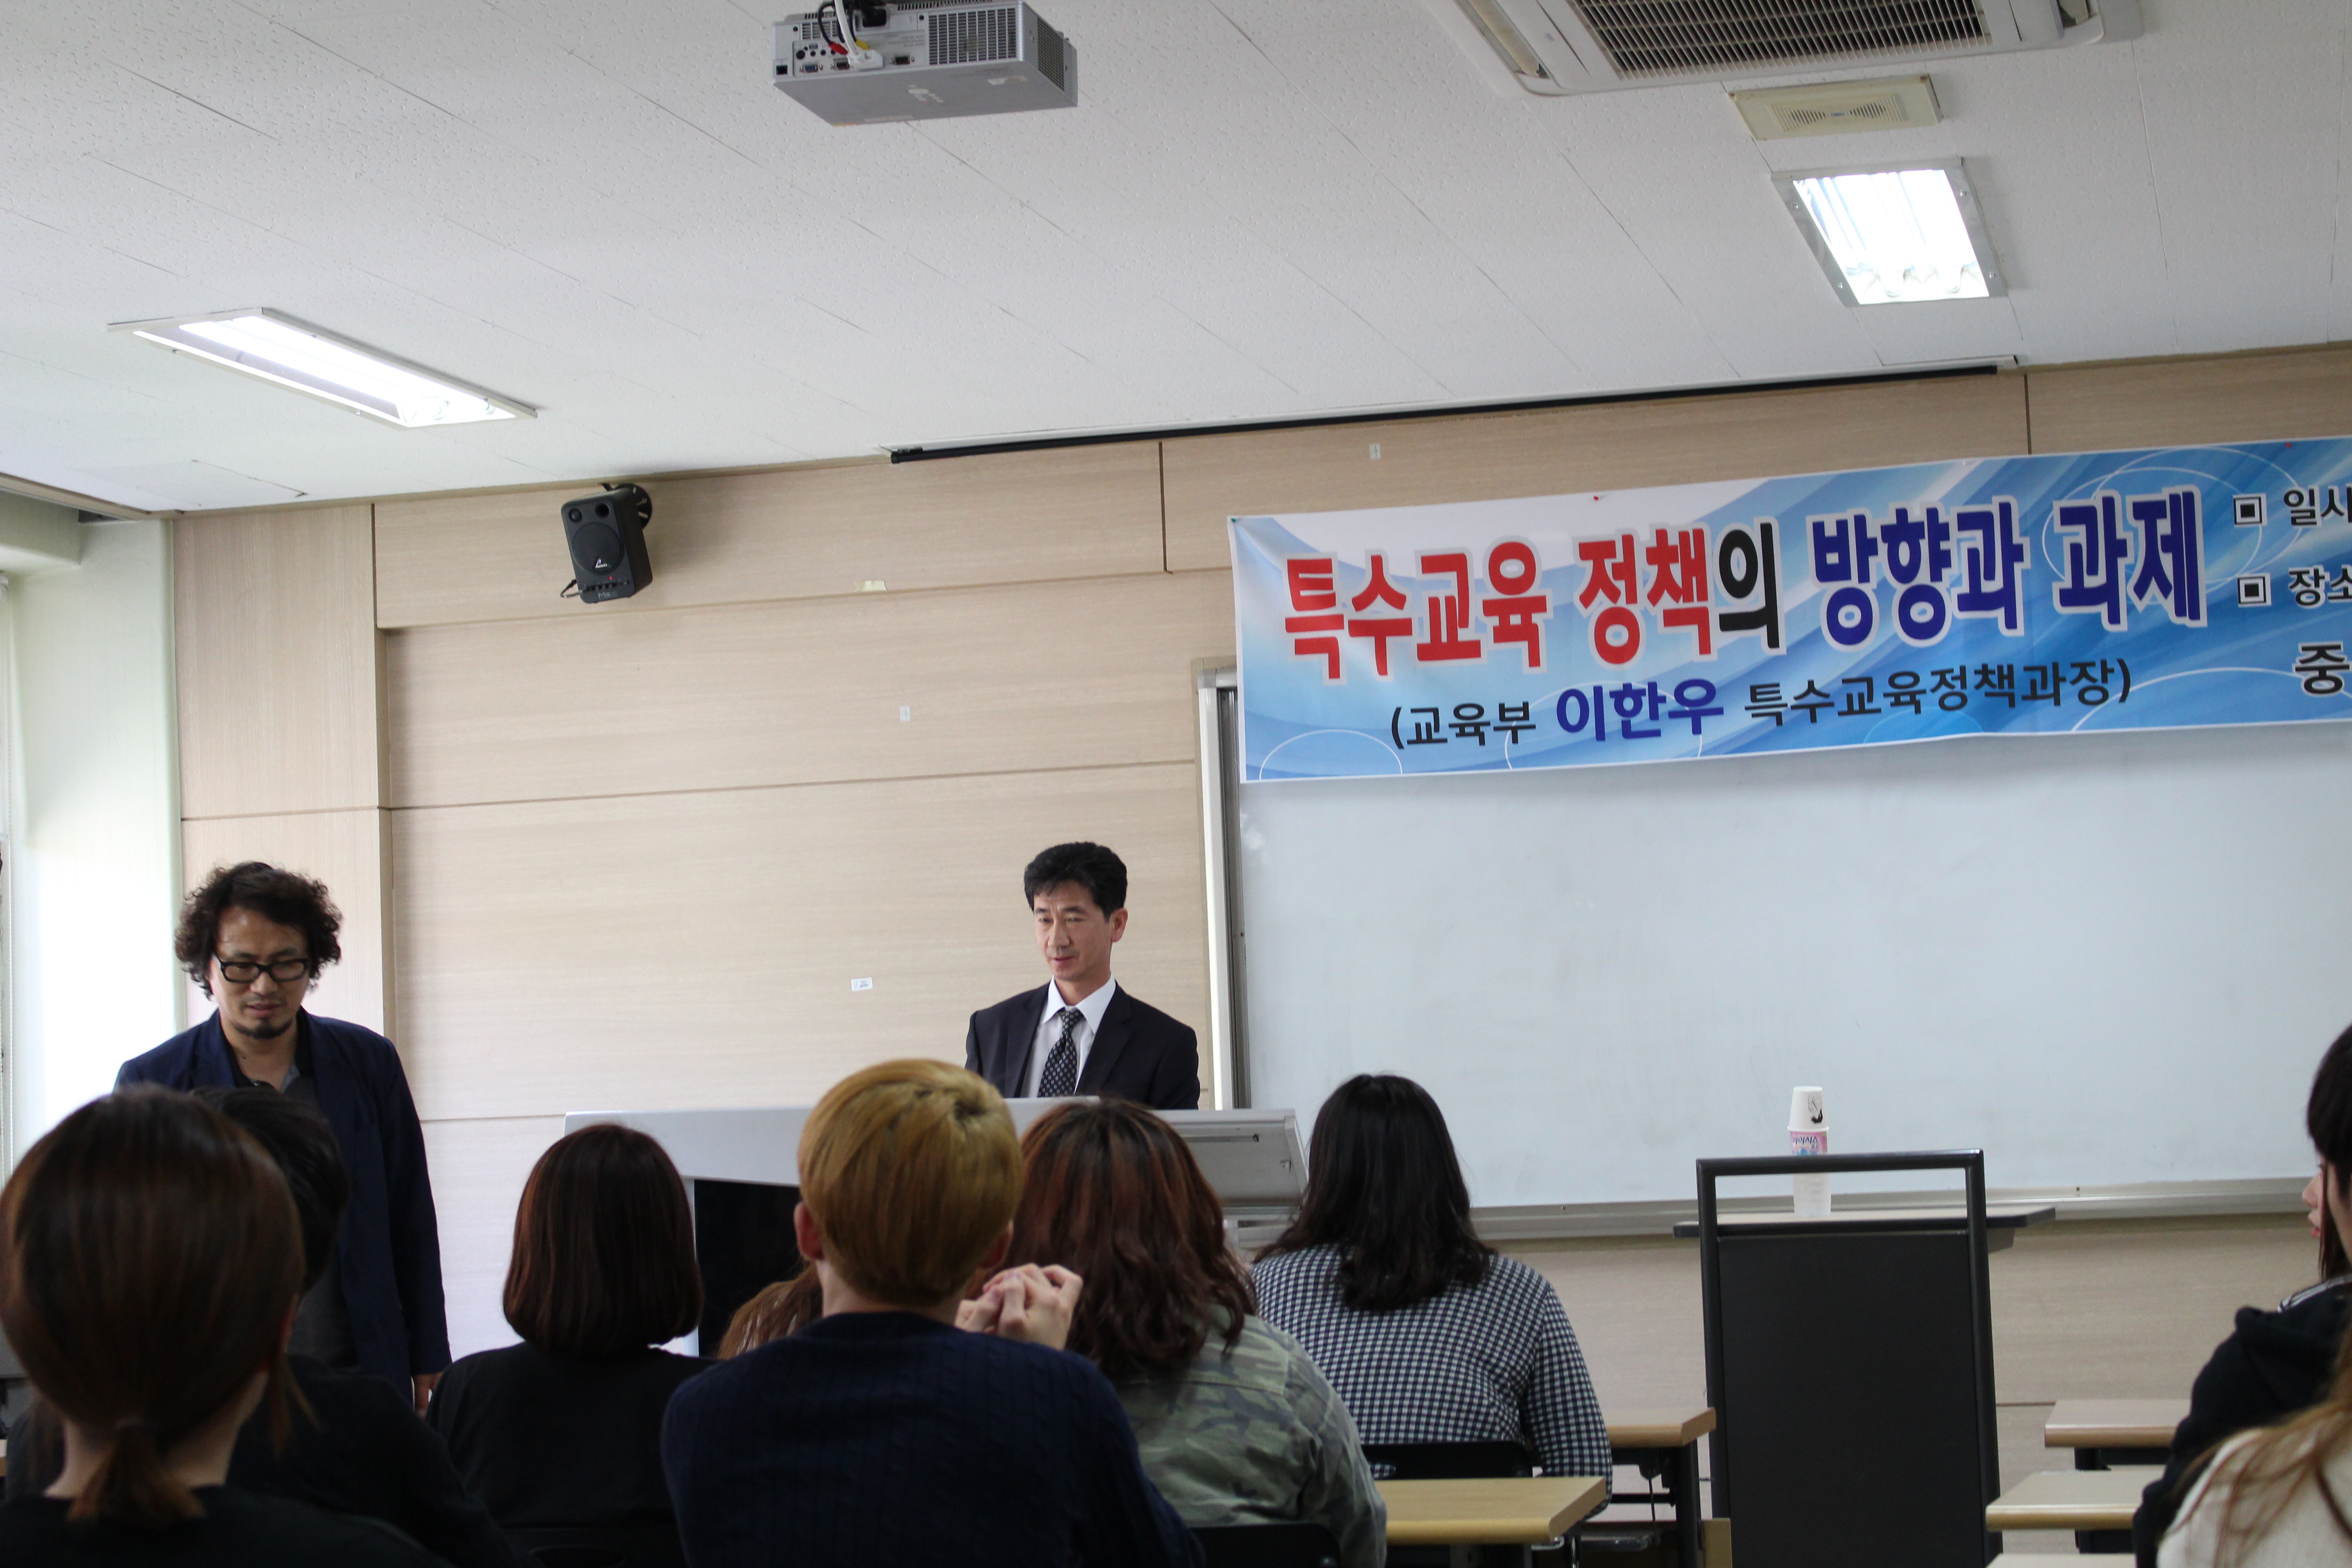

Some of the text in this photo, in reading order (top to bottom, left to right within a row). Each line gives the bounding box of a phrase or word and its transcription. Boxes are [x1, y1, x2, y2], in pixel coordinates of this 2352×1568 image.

[1284, 491, 2201, 680] 특수교육 정책의 방향과 과제
[2288, 568, 2352, 606] 장소
[1391, 658, 2132, 750] (교육부 이한우 특수교육정책과장)
